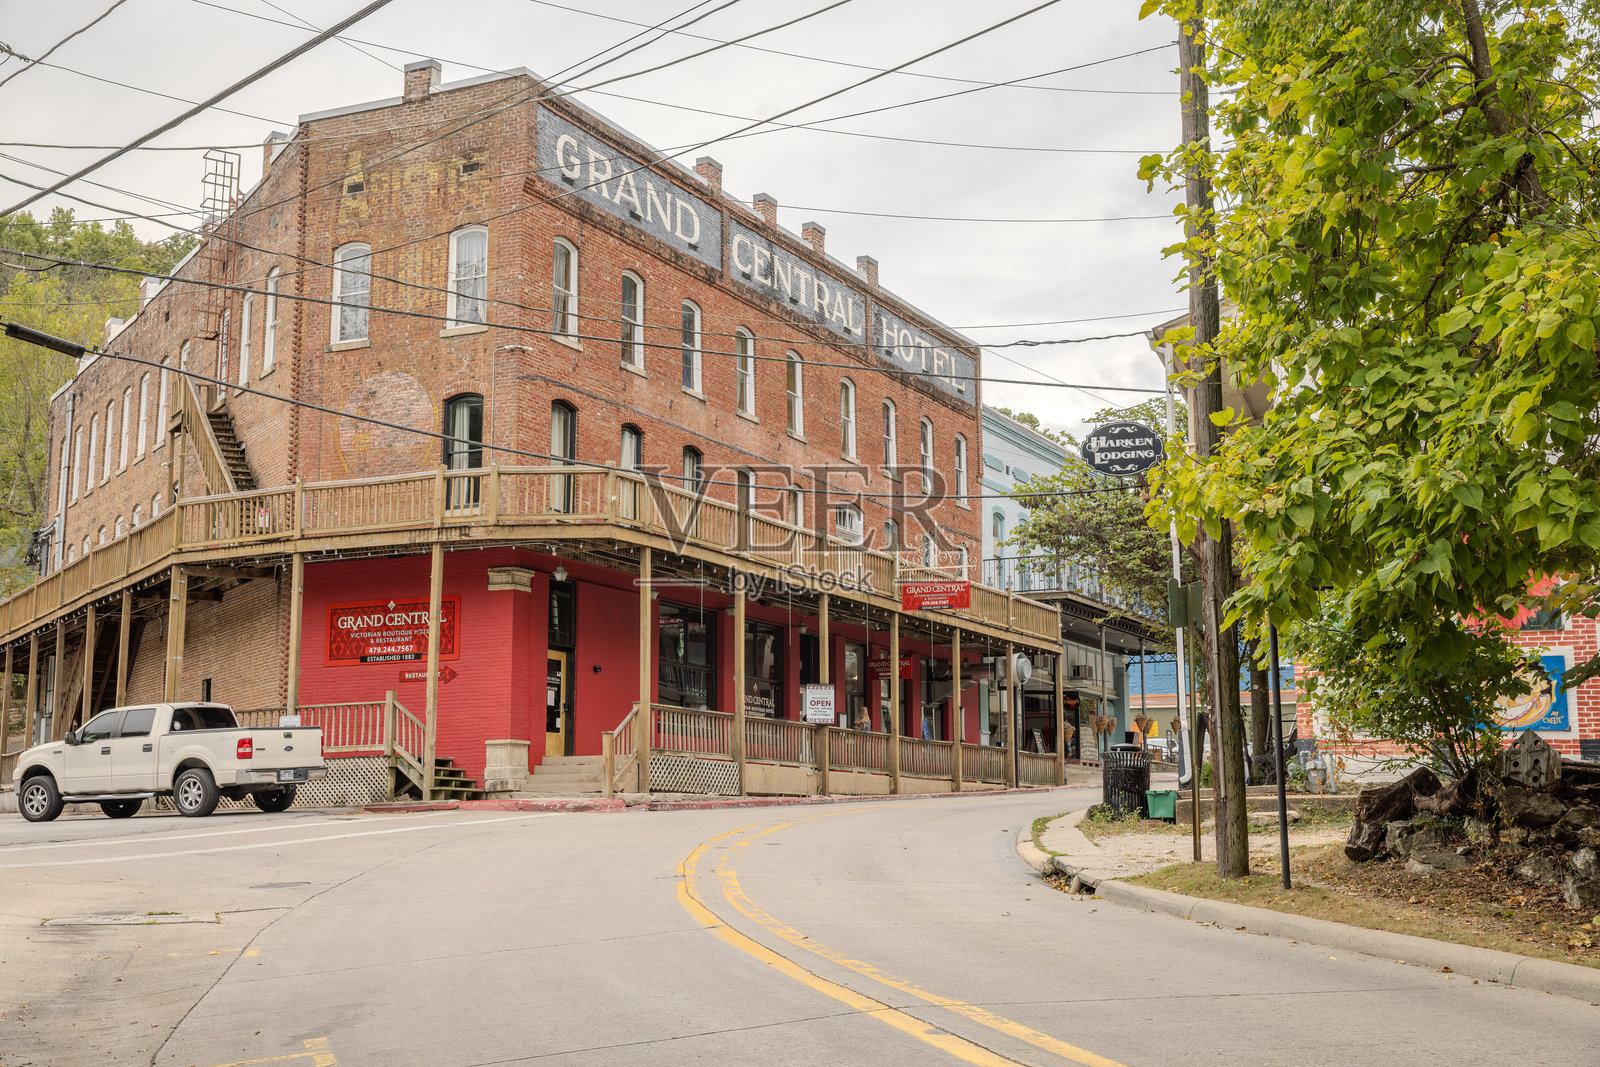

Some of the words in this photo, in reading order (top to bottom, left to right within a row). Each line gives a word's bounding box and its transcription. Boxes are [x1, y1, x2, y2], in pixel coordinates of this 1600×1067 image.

[556, 134, 701, 244] GRAND
[732, 233, 862, 336] CENTRAL
[881, 317, 966, 392] HOTEL
[1086, 436, 1154, 452] HARKEN
[1094, 449, 1155, 465] LODGING
[906, 586, 931, 594] GRAND
[932, 584, 966, 593] CENTRAL
[338, 614, 384, 631] GRAND
[385, 610, 447, 627] CENTRL
[383, 629, 413, 637] BOUTIQUE
[376, 636, 413, 644] RESTAURANT
[368, 645, 414, 654] 479.244.7567
[366, 654, 400, 662] ESTABLISHED
[809, 699, 832, 707] OPEN
